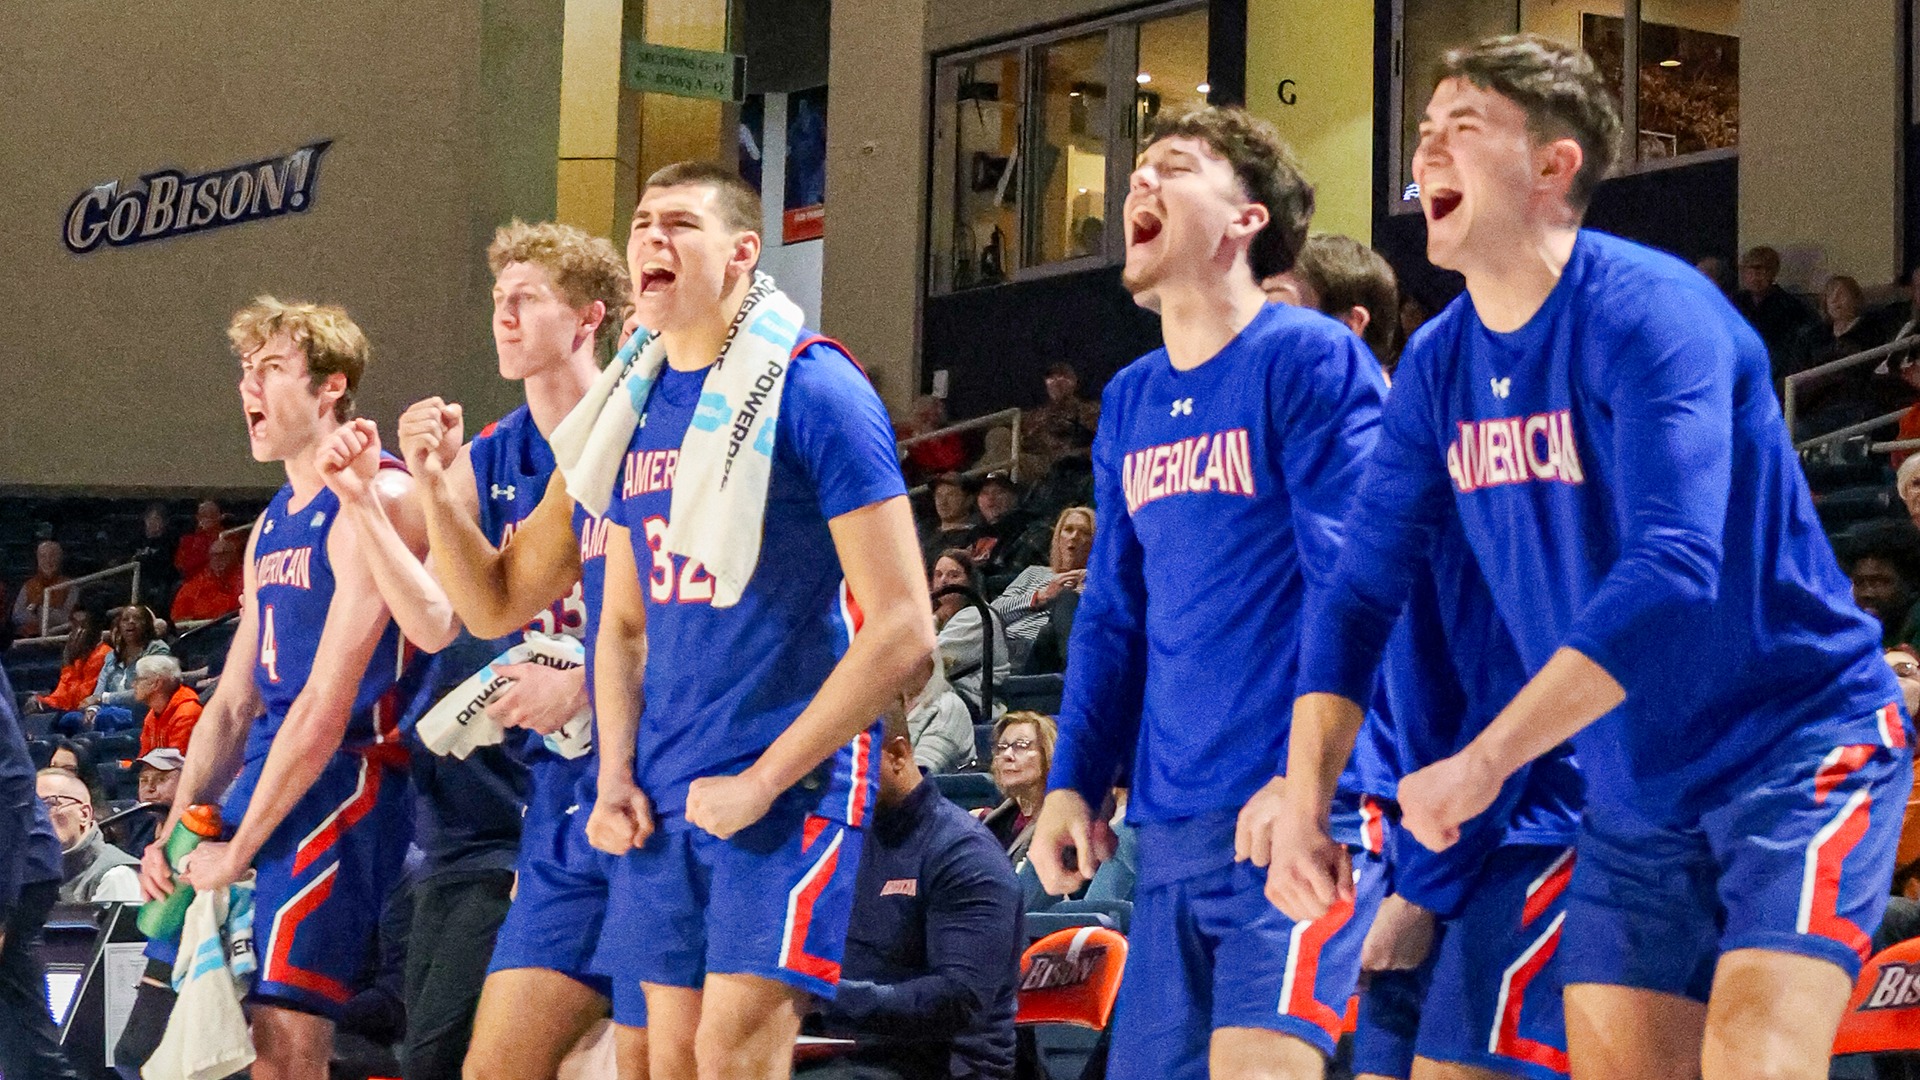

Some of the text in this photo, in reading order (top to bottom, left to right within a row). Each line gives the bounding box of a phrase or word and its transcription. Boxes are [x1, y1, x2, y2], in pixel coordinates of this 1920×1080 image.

[1277, 79, 1297, 105] G
[622, 448, 681, 500] AMER
[1123, 427, 1257, 517] AMERICAN
[254, 546, 312, 590] MERICAN
[261, 604, 280, 684] 4
[1868, 965, 1920, 1008] BIS
